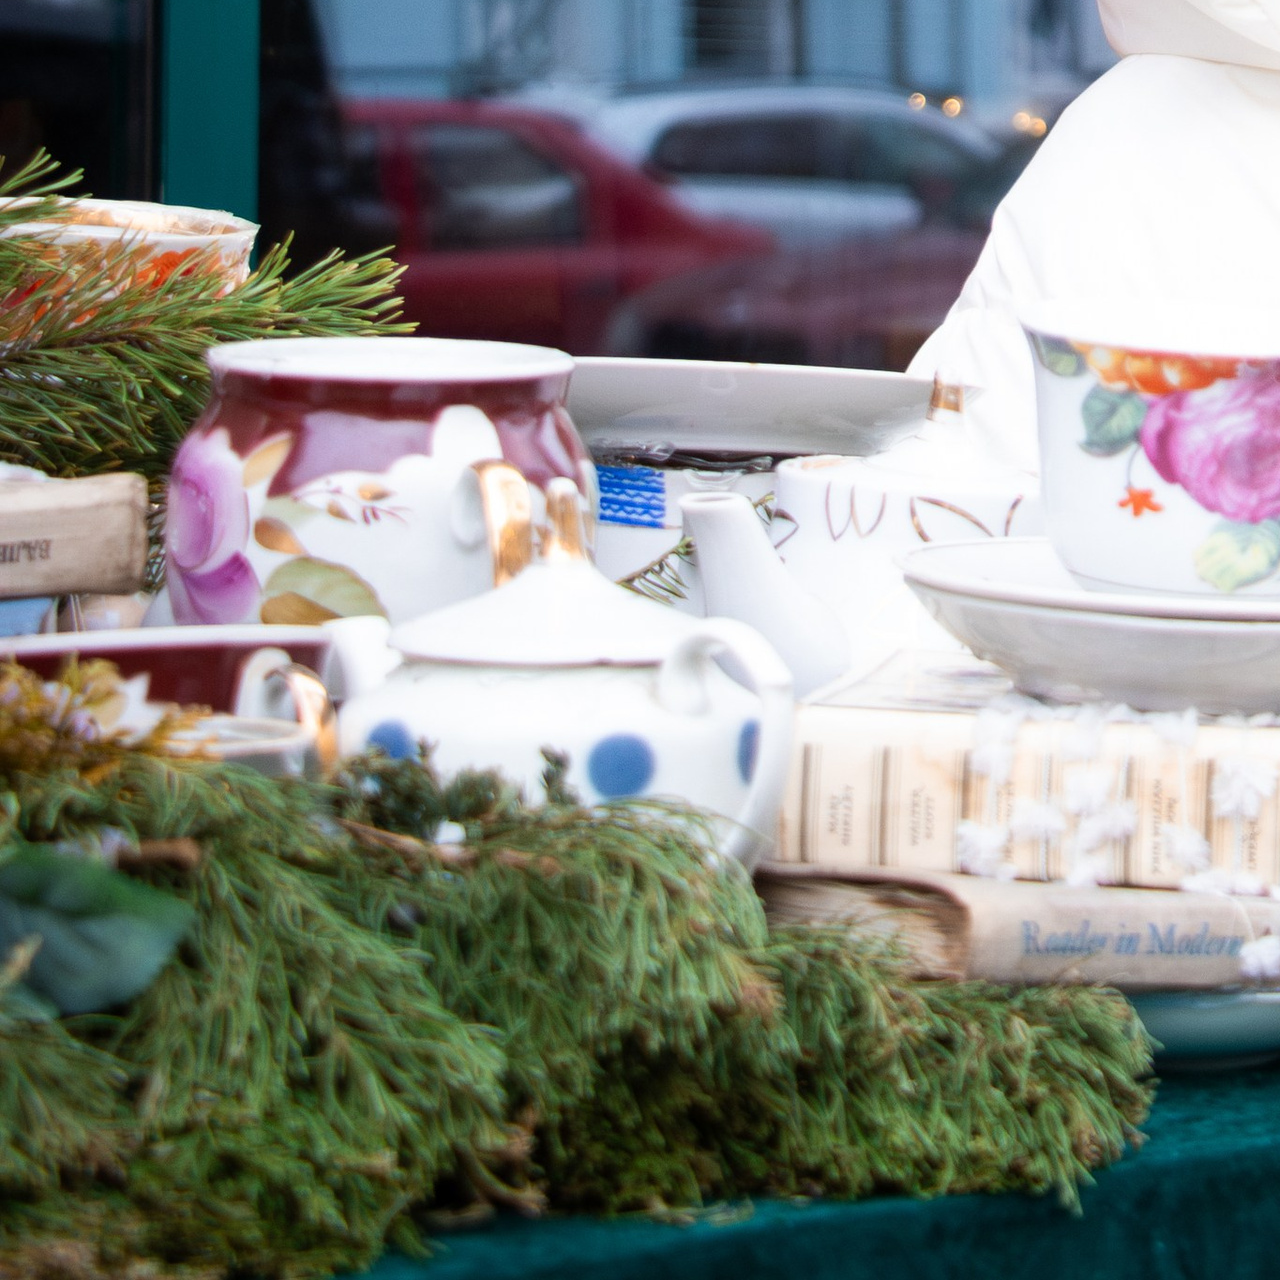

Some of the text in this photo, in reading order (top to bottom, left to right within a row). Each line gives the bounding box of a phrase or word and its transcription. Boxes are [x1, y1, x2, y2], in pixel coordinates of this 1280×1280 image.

[1022, 920, 1109, 955] Reader
[1114, 922, 1141, 955] in
[1146, 922, 1245, 955] Modern
